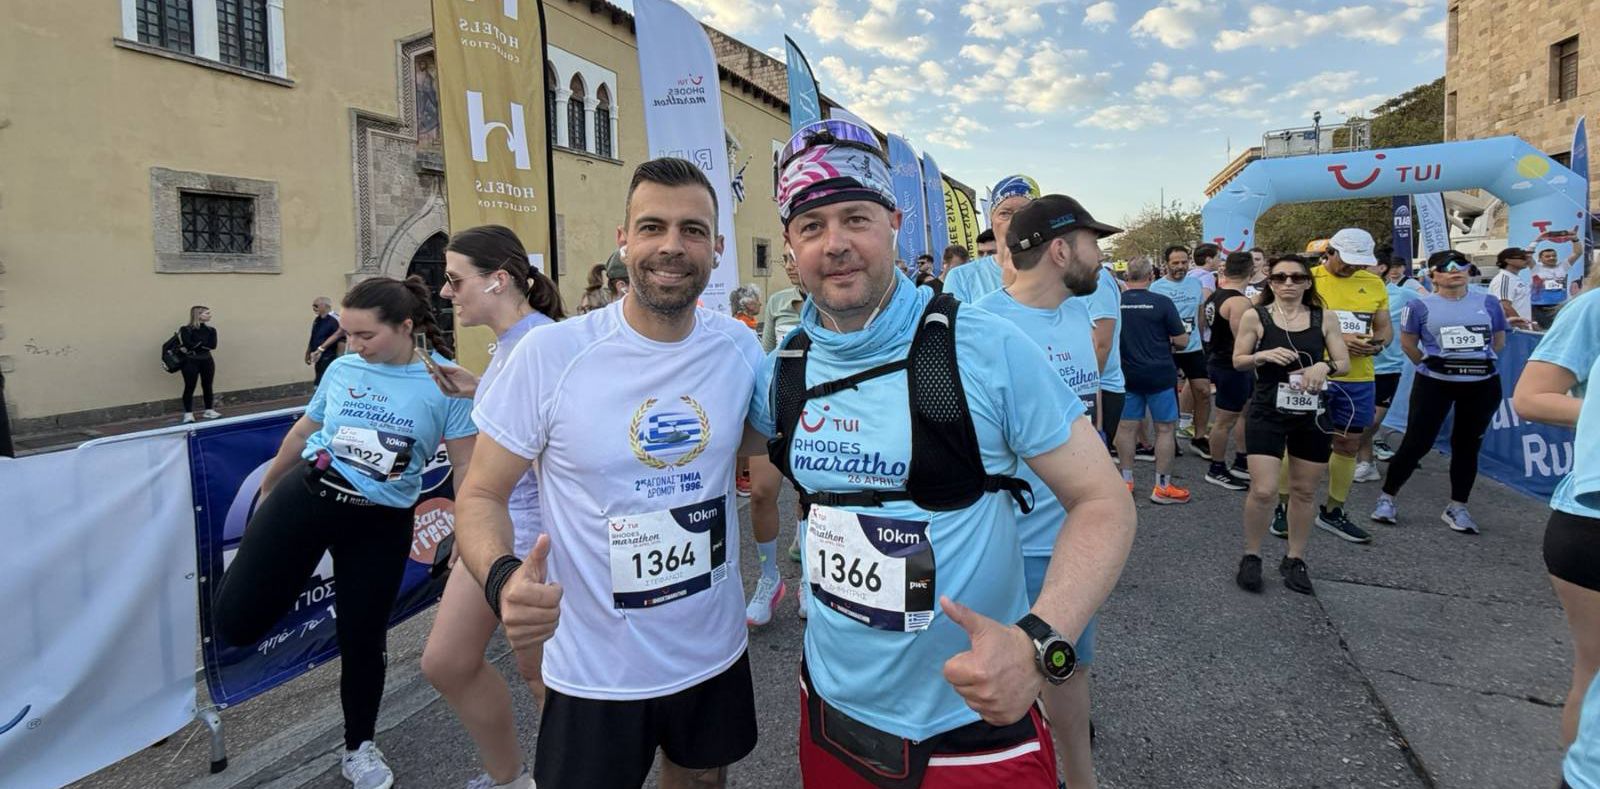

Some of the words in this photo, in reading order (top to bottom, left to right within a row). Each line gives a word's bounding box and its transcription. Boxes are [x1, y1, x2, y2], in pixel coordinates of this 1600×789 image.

[1396, 163, 1442, 183] TUI
[1450, 335, 1476, 345] 1393
[1056, 352, 1072, 362] TUI
[371, 394, 388, 403] TUI
[1286, 396, 1312, 406] 1384
[342, 401, 387, 413] RHODES
[339, 408, 415, 428] marathon
[832, 418, 859, 433] TUI
[386, 437, 408, 448] 10km
[794, 439, 861, 455] RHODES
[848, 474, 861, 484] 26
[864, 476, 897, 487] APRIL
[687, 509, 718, 524] 10km
[611, 533, 660, 546] marathon
[876, 527, 920, 545] 10km
[632, 541, 696, 579] 1364
[818, 549, 882, 593] 1366
